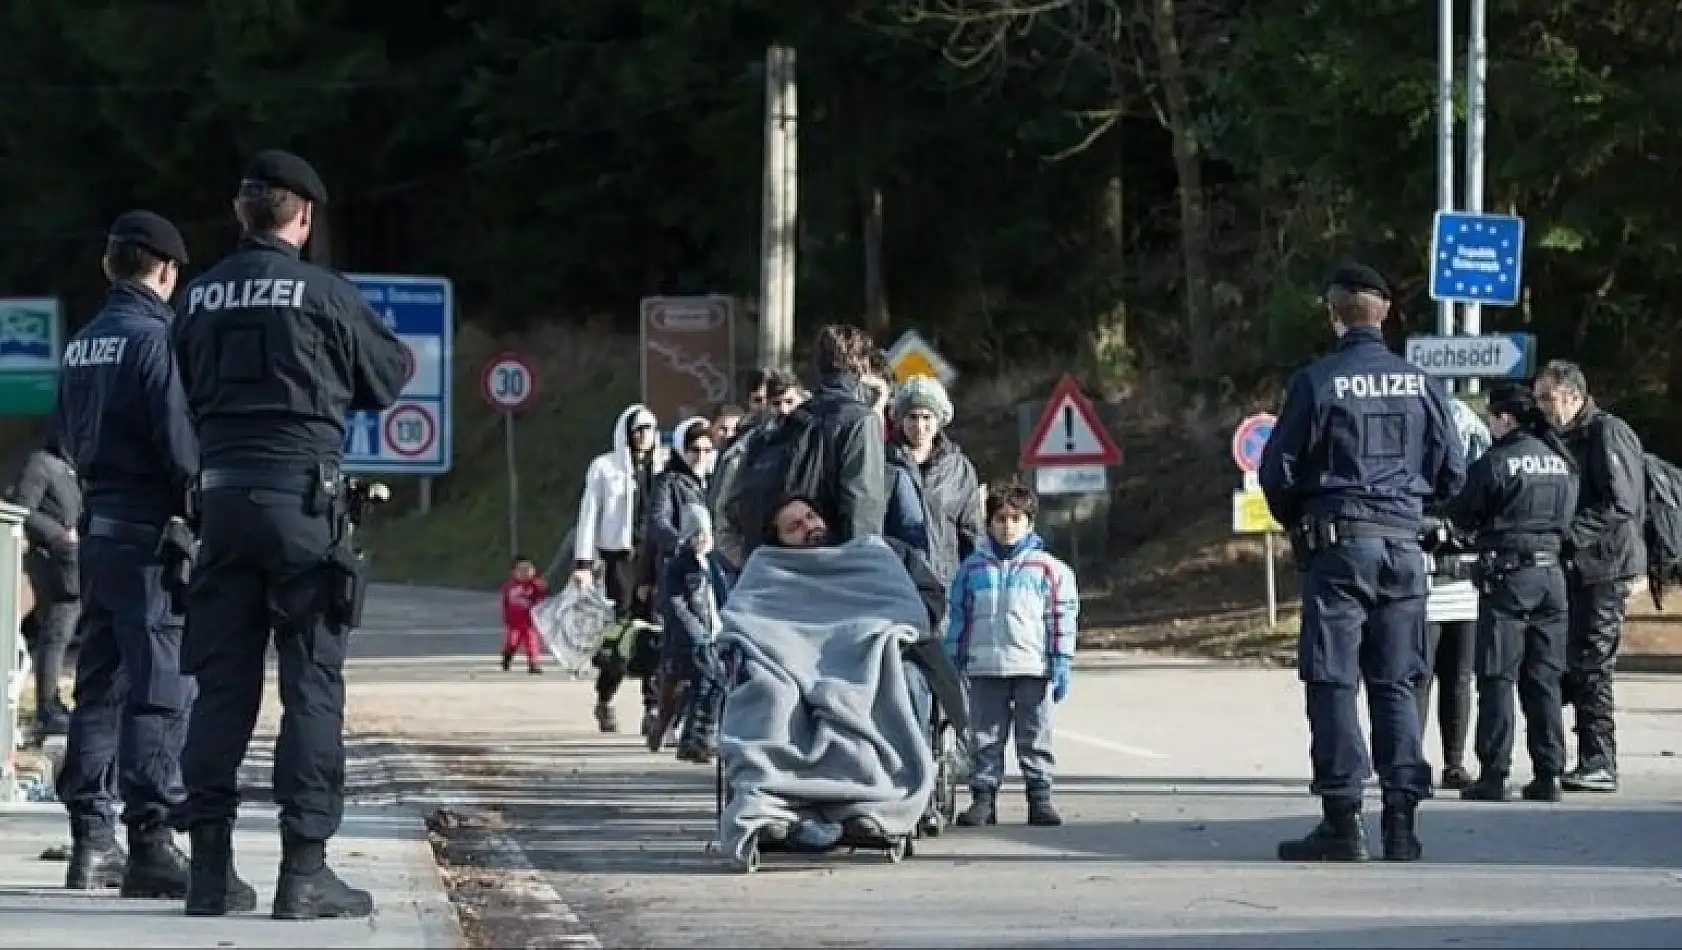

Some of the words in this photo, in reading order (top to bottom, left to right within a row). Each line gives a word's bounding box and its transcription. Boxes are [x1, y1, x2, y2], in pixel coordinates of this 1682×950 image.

[188, 279, 306, 314] POLIZEI
[496, 368, 525, 396] 30
[1334, 373, 1426, 399] POLIZEI
